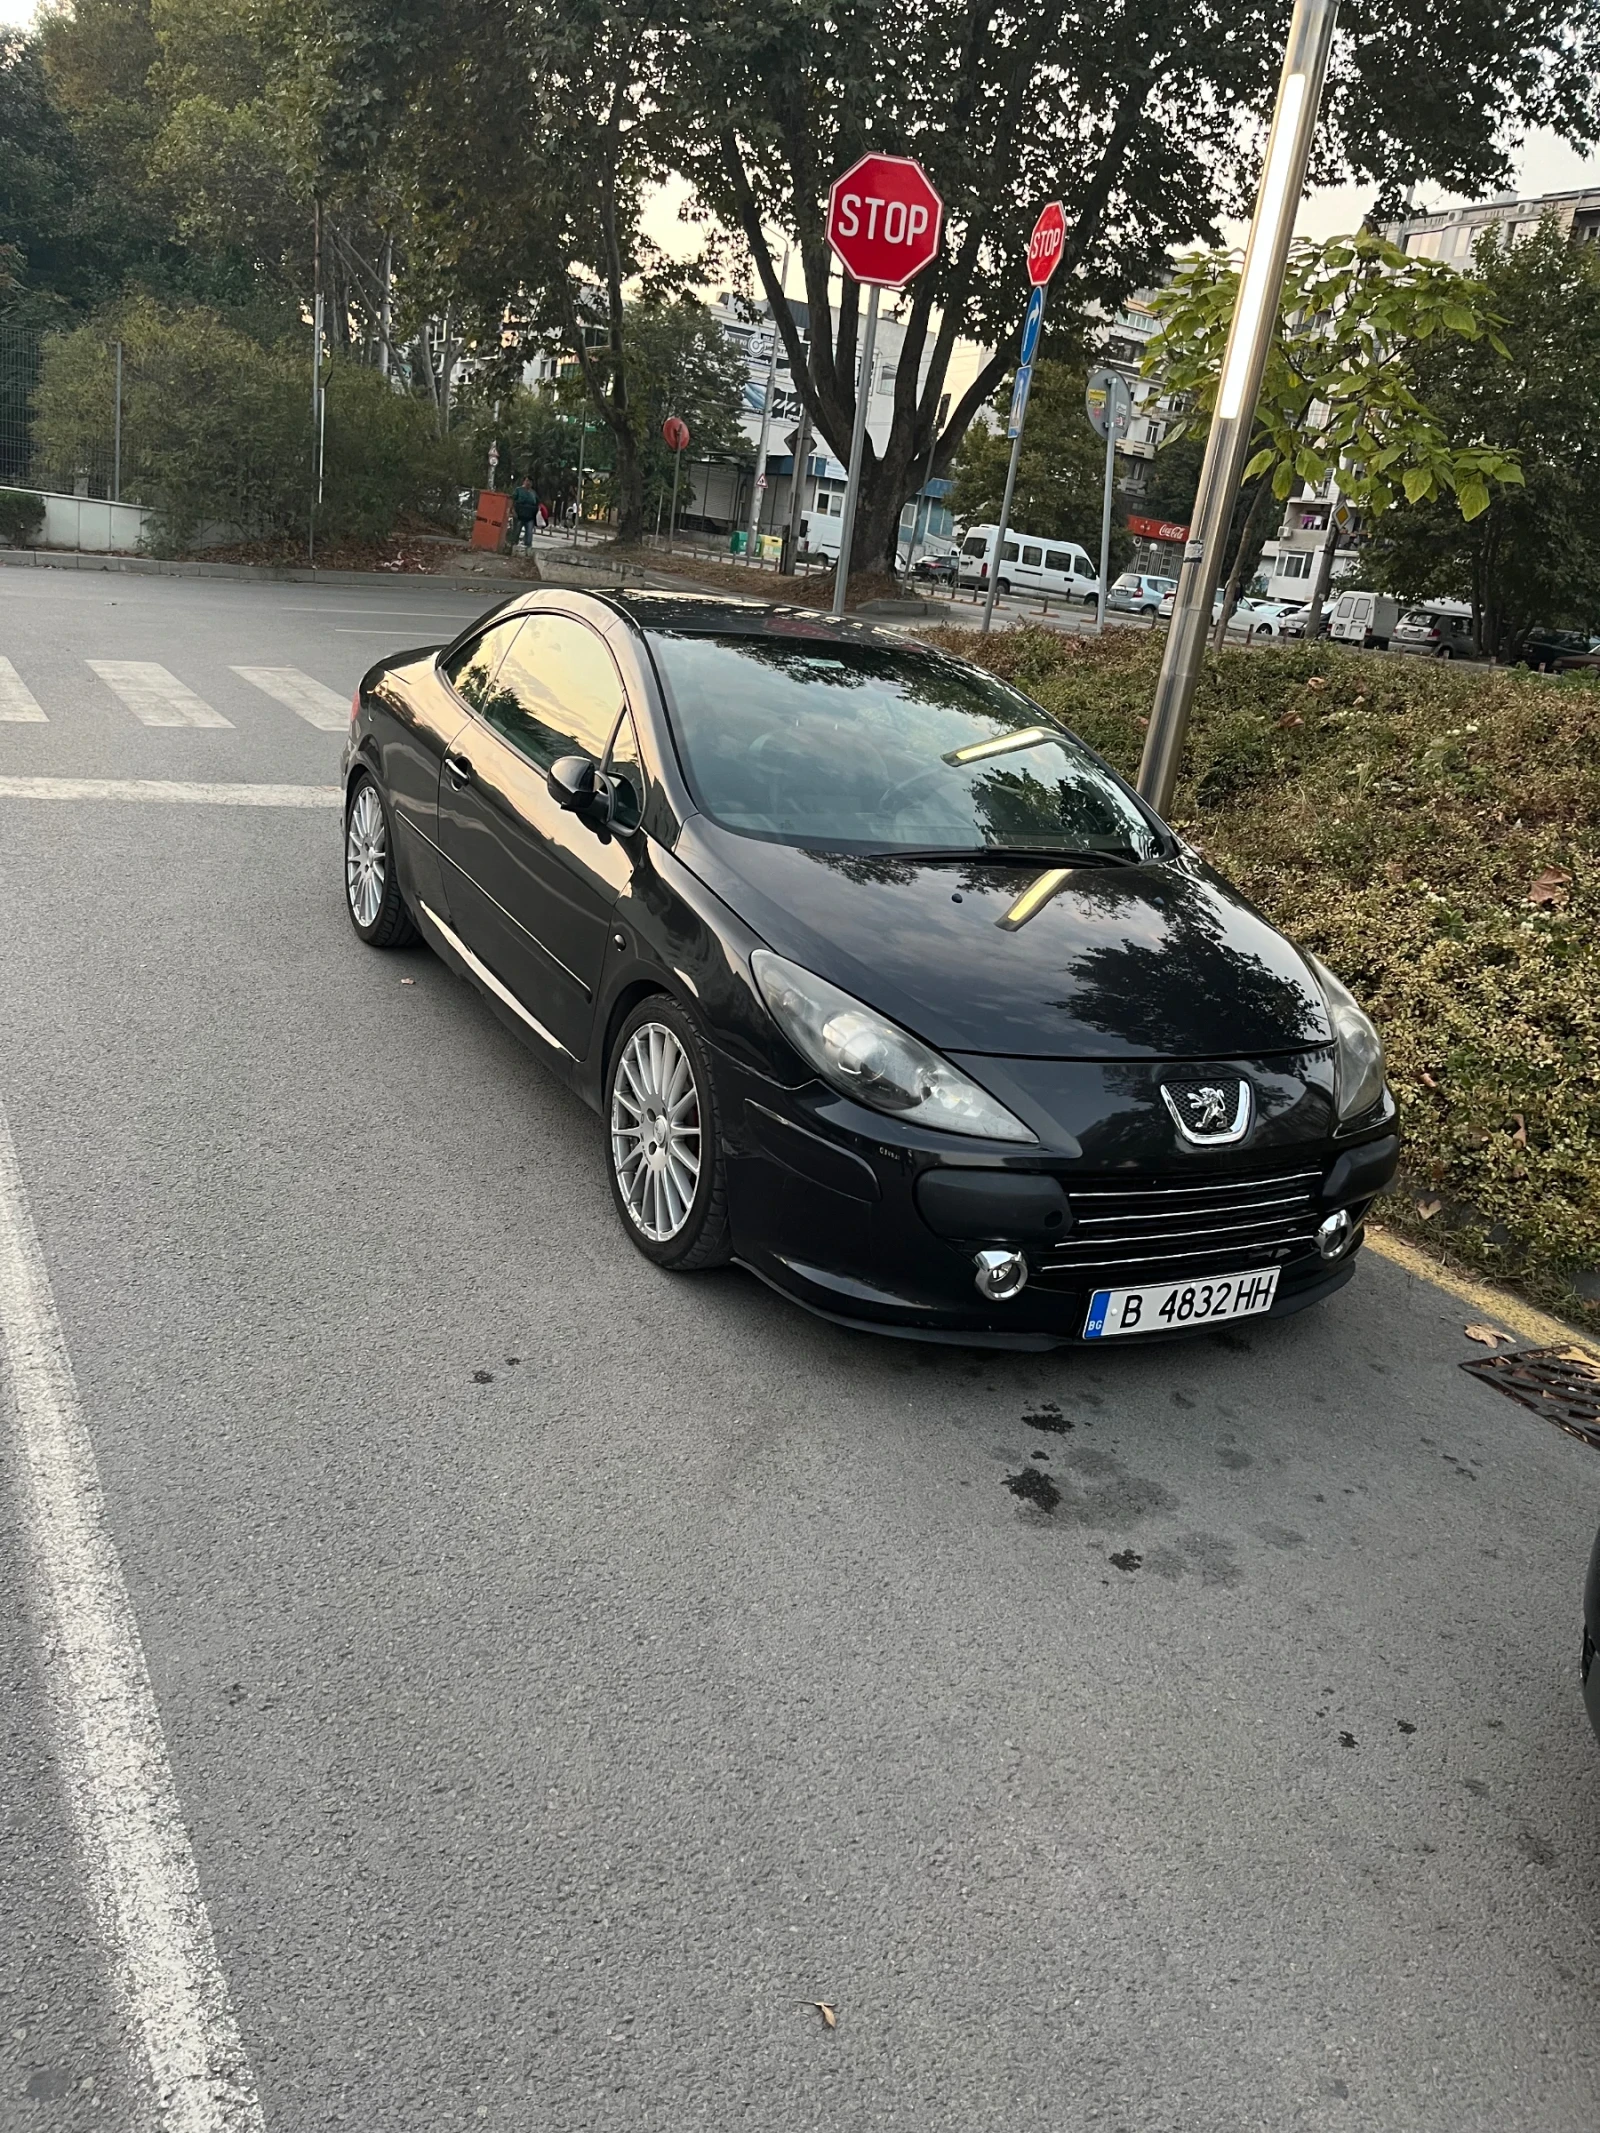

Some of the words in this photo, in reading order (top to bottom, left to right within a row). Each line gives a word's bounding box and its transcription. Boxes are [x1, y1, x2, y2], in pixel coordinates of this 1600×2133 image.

[838, 193, 929, 246] STOP
[1030, 227, 1061, 260] STOP
[1088, 1320, 1102, 1331] BG
[1119, 1294, 1143, 1329] B
